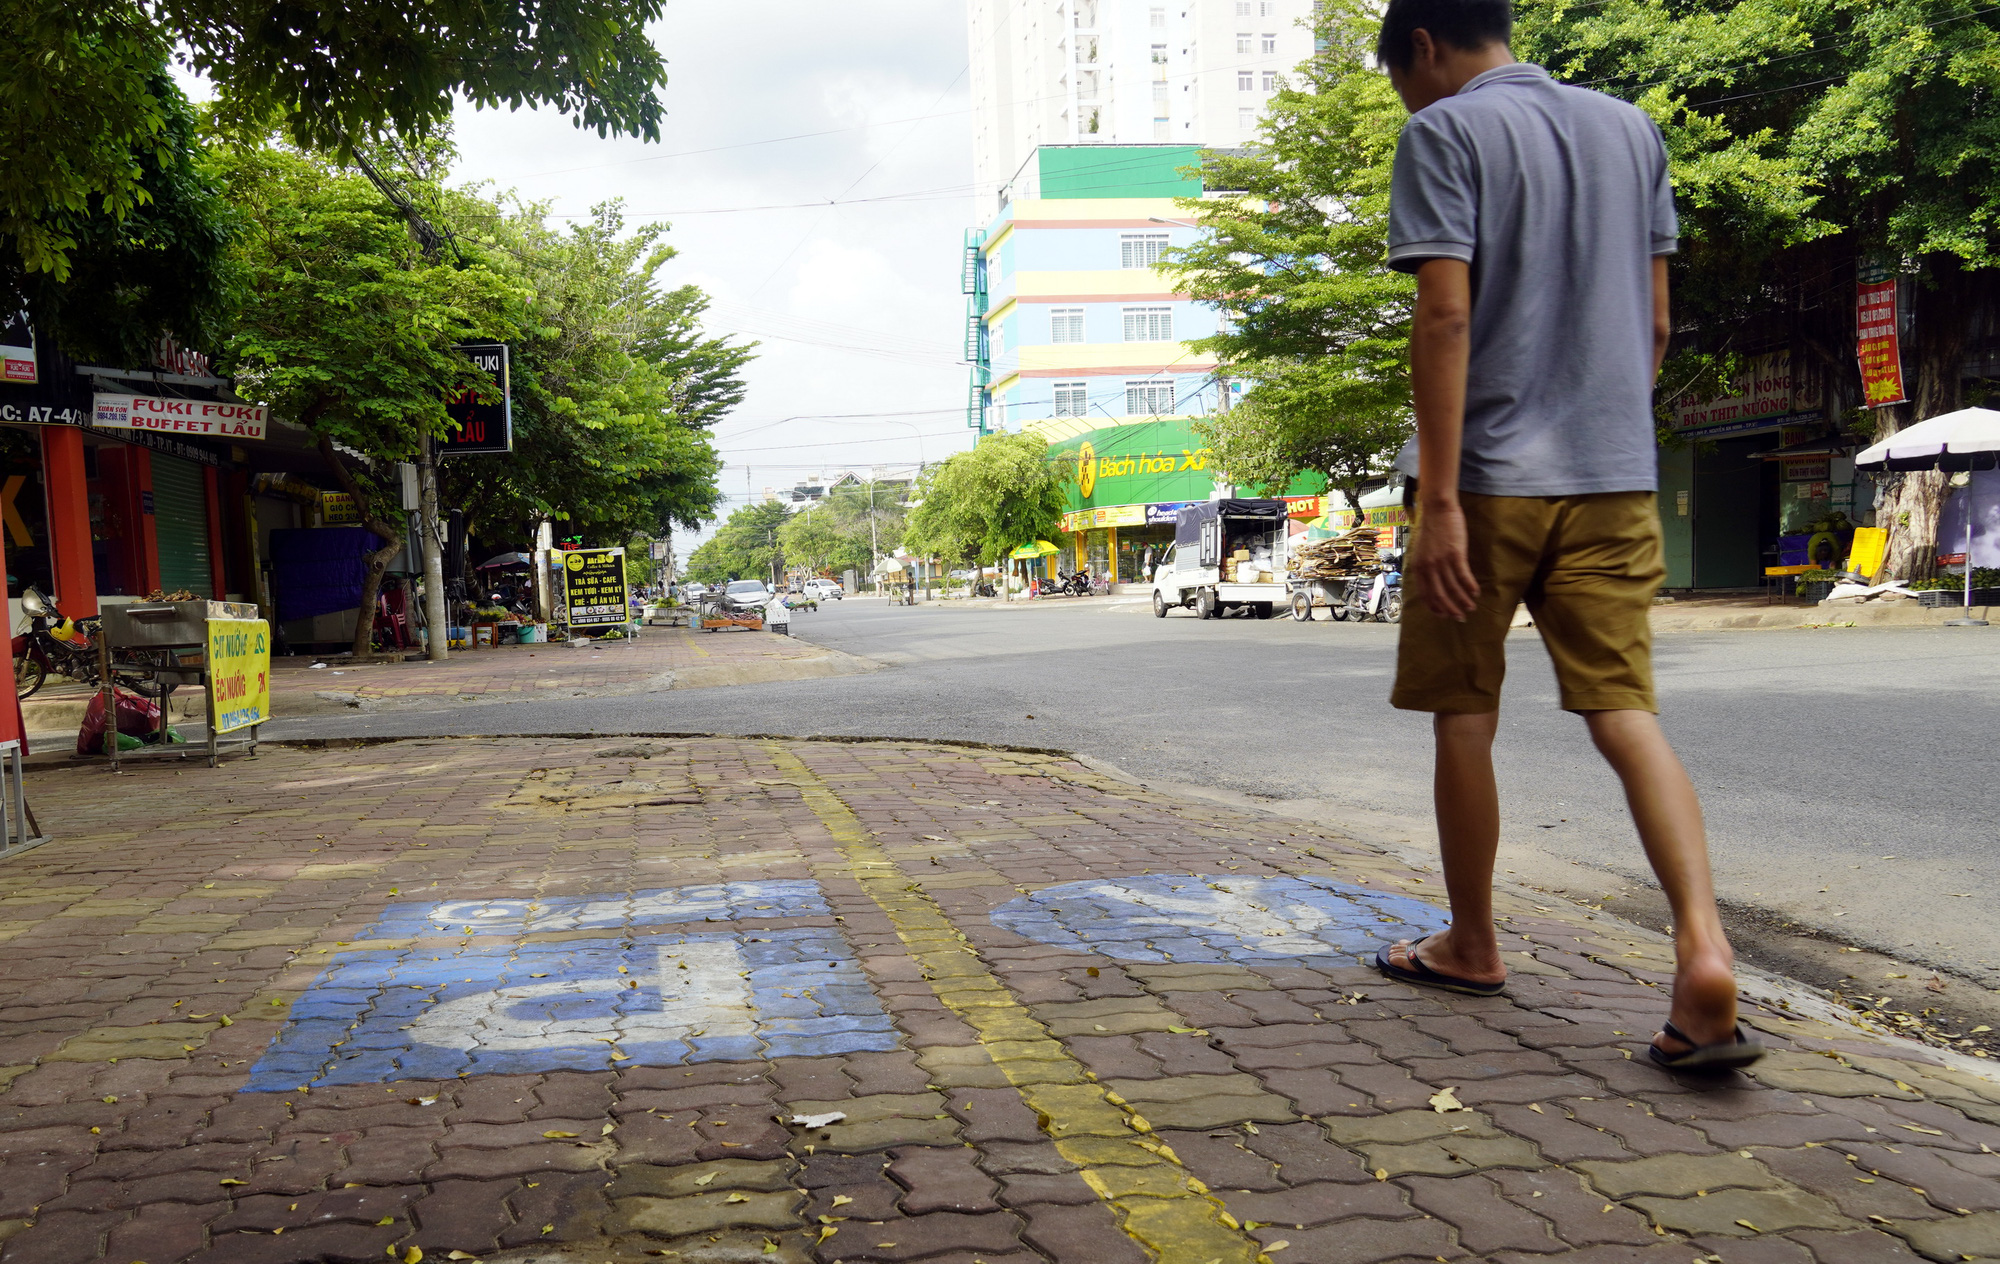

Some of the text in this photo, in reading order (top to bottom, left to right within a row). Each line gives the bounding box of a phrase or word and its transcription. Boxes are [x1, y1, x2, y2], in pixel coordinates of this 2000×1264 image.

[474, 355, 499, 371] FUKI
[1754, 375, 1792, 395] NÓNG
[0, 404, 22, 420] C:
[132, 399, 262, 420] FUKI FUKI
[1683, 396, 1789, 426] BÚN THỊT NƯỚNG
[131, 416, 261, 437] BUFFET LẨU
[1099, 454, 1136, 478] Bách
[1138, 450, 1176, 475] hóa
[1287, 499, 1315, 514] HOT
[1372, 510, 1387, 526] SẠCH
[575, 576, 616, 585] TRÀ SỮA CAFE
[601, 586, 613, 594] KEM
